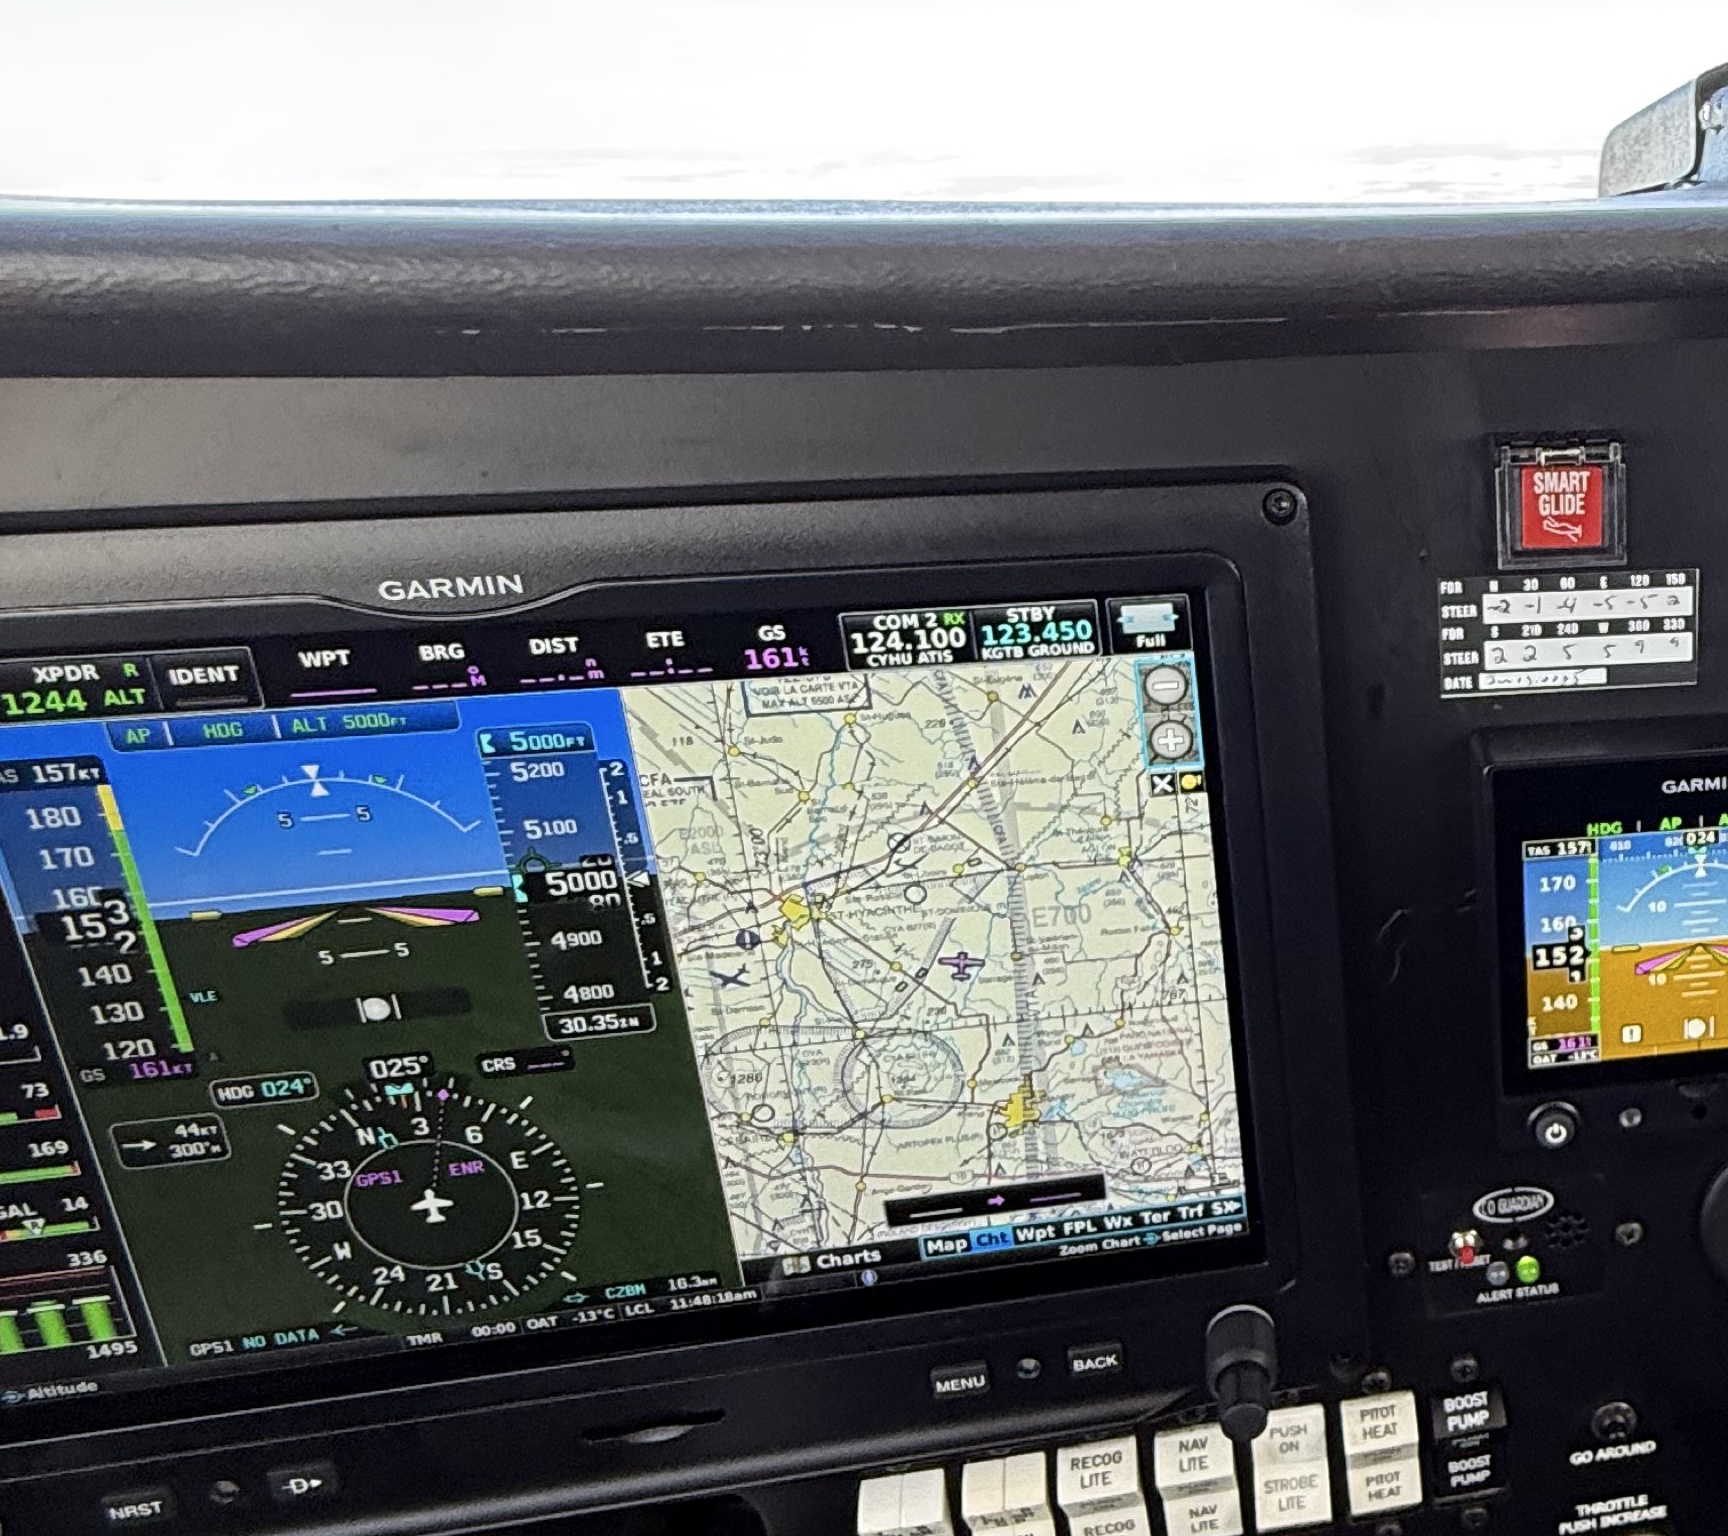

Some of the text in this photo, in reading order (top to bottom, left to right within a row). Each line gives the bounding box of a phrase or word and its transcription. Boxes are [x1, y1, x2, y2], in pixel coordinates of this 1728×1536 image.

[1533, 471, 1590, 494] SMART
[1538, 494, 1585, 517] GLIDE
[379, 574, 524, 601] GARMIN
[873, 615, 917, 630] COM
[1007, 606, 1055, 623] STBY
[646, 630, 684, 650] ETE
[852, 627, 968, 653] 124.100
[981, 620, 1093, 645] 123.450
[1136, 632, 1165, 649] Full
[420, 642, 465, 661] BRG
[529, 636, 579, 656] DIST
[868, 647, 954, 665] CYHU ATIS
[1029, 640, 1094, 657] GROUND
[299, 649, 350, 668] WPT
[33, 665, 99, 685] XPDR
[169, 665, 240, 686] IDENT
[2, 687, 146, 715] 1244 ALT
[511, 760, 565, 781] 5200
[25, 807, 82, 830] 180
[523, 818, 577, 839] 5100
[1587, 821, 1622, 836] HDG
[1659, 817, 1682, 830] AP
[40, 846, 94, 870] 170
[546, 871, 618, 897] 5000
[1540, 876, 1576, 891] 170
[78, 964, 133, 987] 140
[1542, 994, 1578, 1011] 140
[103, 1038, 156, 1059] 120
[482, 1056, 516, 1073] CRS
[218, 1082, 255, 1101] HDG
[318, 1160, 351, 1181] 33
[520, 1190, 550, 1209] 12
[310, 1200, 343, 1221] 30
[512, 1229, 541, 1248] 15
[927, 1212, 1134, 1257] Map Wpt FPL Wx
[817, 1247, 882, 1269] Charts
[374, 1265, 406, 1286] 24
[1516, 1282, 1559, 1298] STATUS
[243, 1326, 319, 1351] NO DATA
[1072, 1353, 1117, 1372] BACK
[935, 1373, 986, 1394] MENU
[1443, 1392, 1489, 1412] BOOST
[1448, 1408, 1489, 1430] PUMP
[1179, 1437, 1209, 1453] NAV
[1570, 1440, 1656, 1465] GO AROUND
[1069, 1451, 1123, 1470] RECOG
[1079, 1470, 1113, 1488] LITE
[108, 1500, 164, 1520] NRST
[1576, 1495, 1648, 1516] THROTTLE
[1559, 1505, 1667, 1535] PUSH INCREASE
